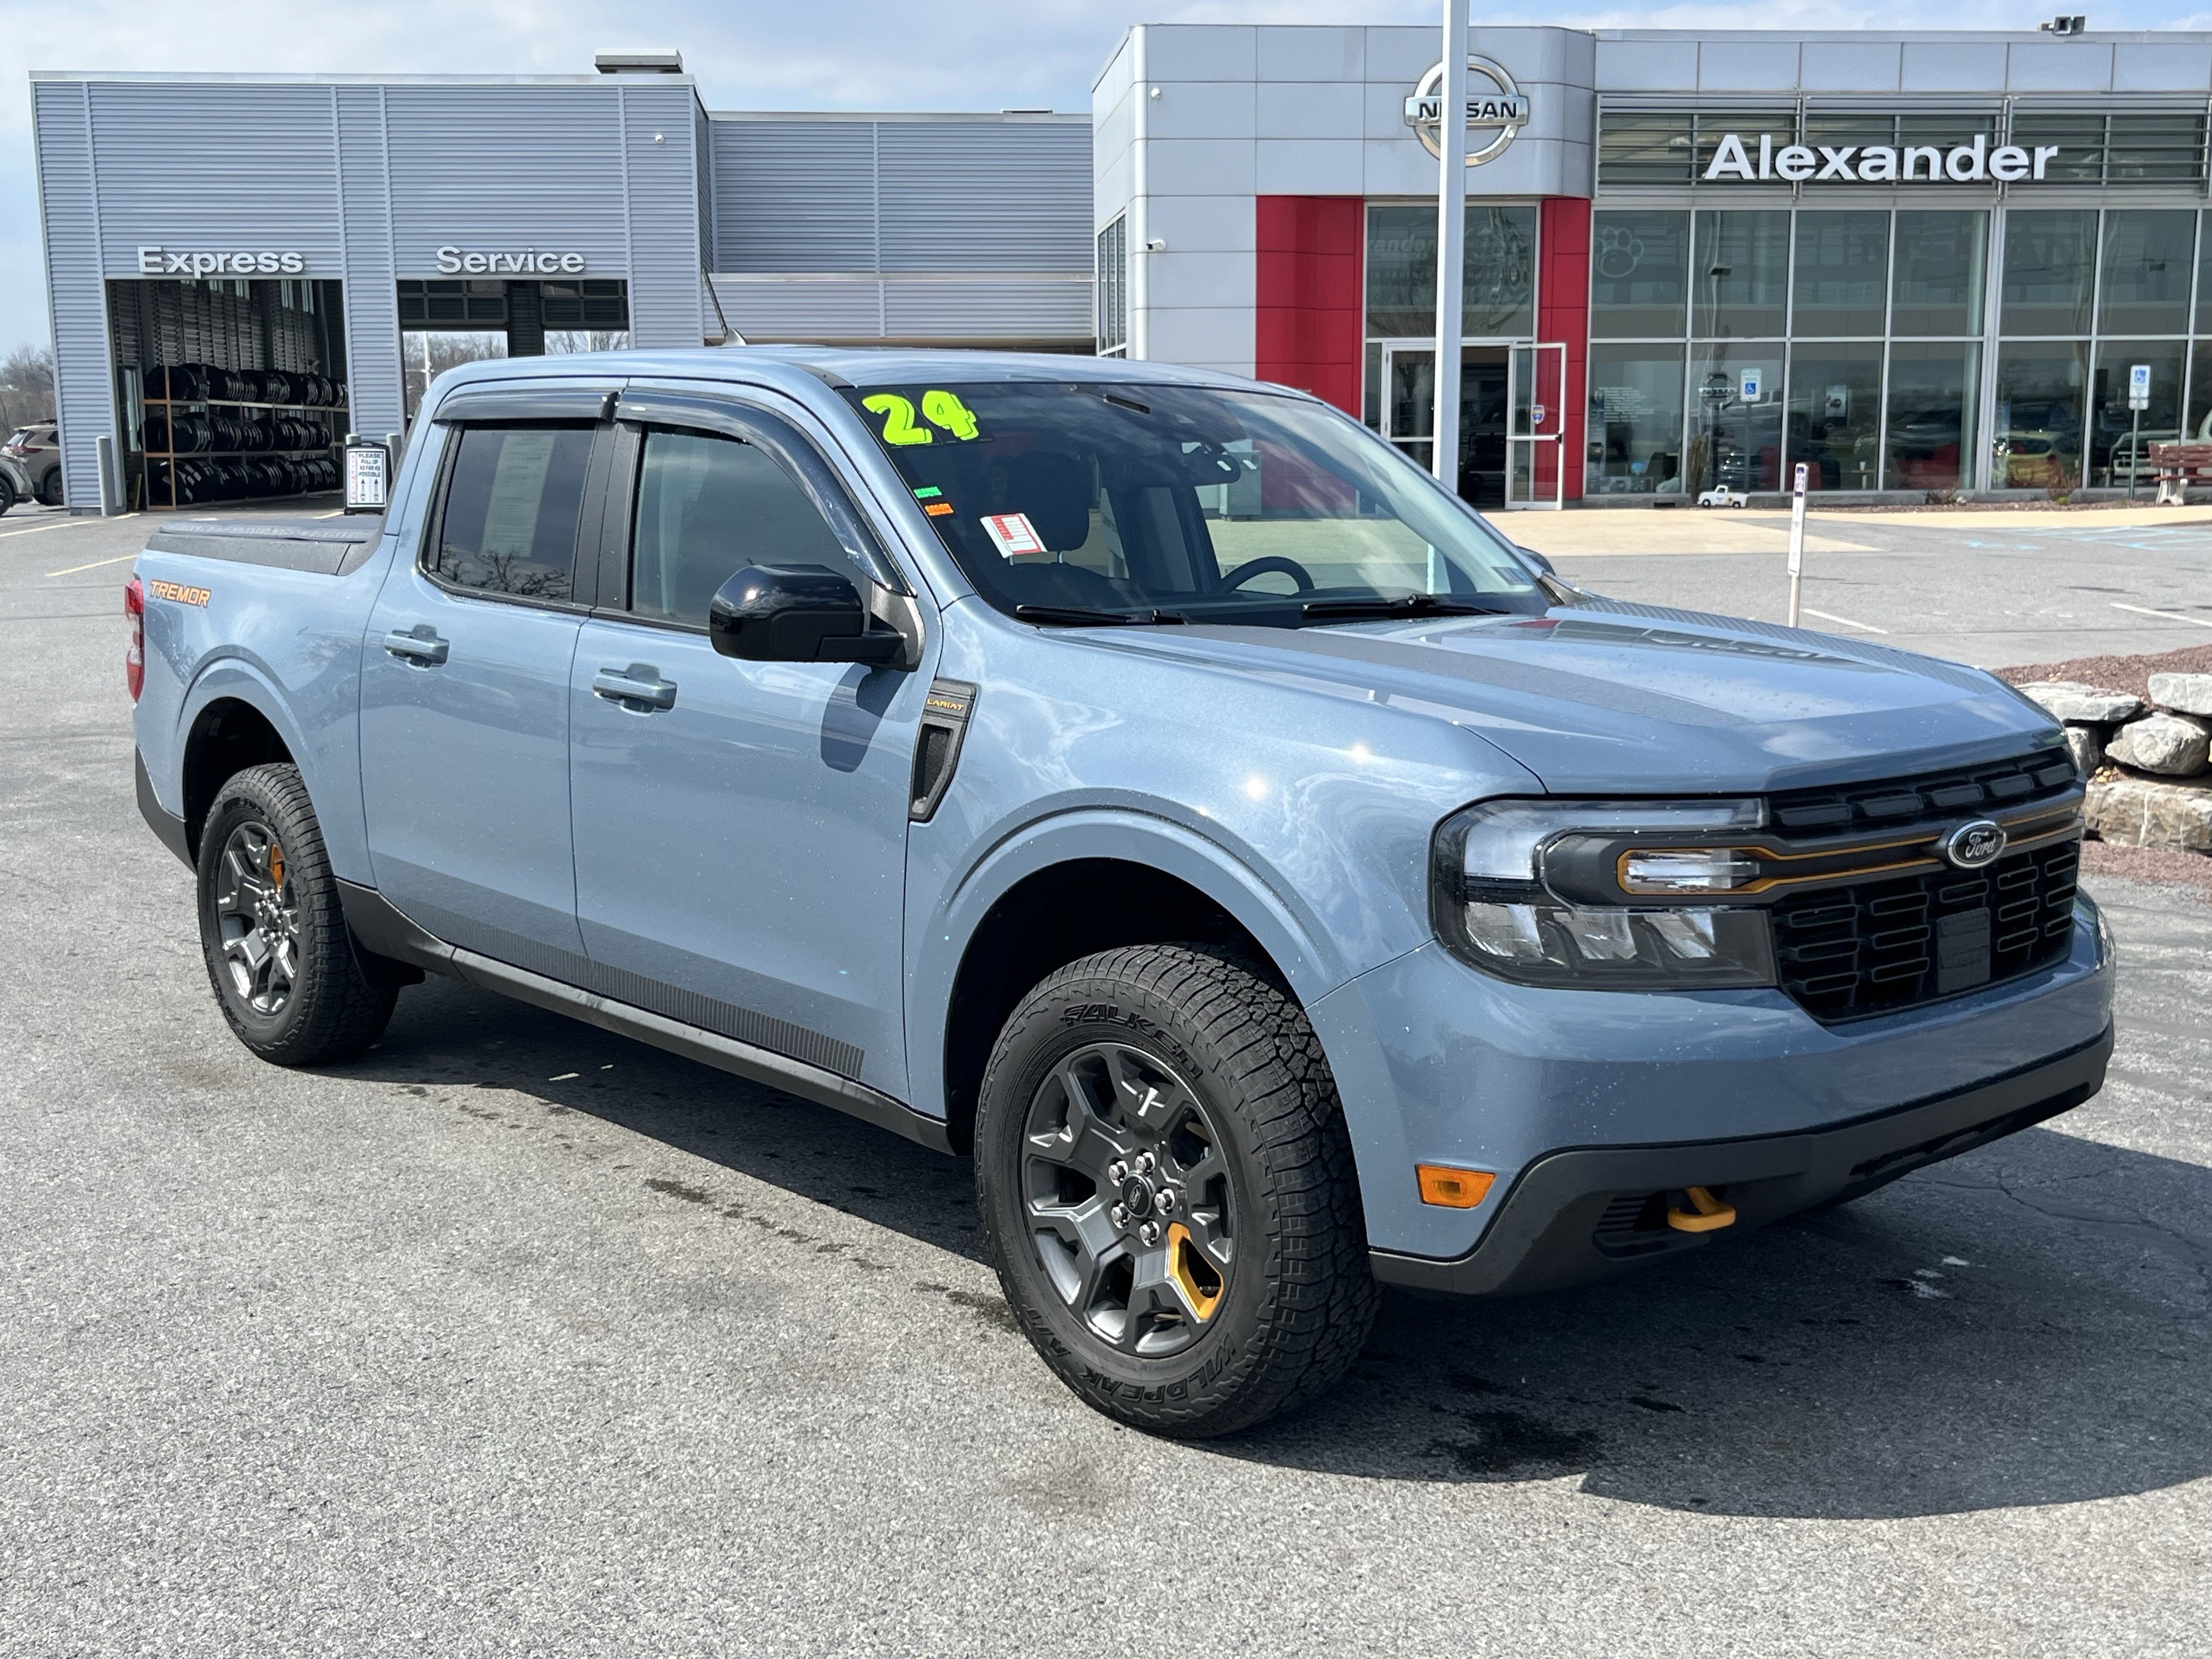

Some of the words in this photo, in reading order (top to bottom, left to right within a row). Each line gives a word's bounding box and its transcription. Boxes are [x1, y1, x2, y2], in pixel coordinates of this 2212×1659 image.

[1703, 134, 2058, 182] Alexander
[137, 246, 304, 279] Express
[436, 246, 585, 275] Service
[862, 390, 979, 445] 24
[150, 579, 211, 608] TREMOR
[927, 698, 964, 711] LARIAT
[1965, 831, 1996, 859] Ford
[1059, 1002, 1204, 1080] FALKEN
[1079, 1332, 1236, 1404] WILDPEAK
